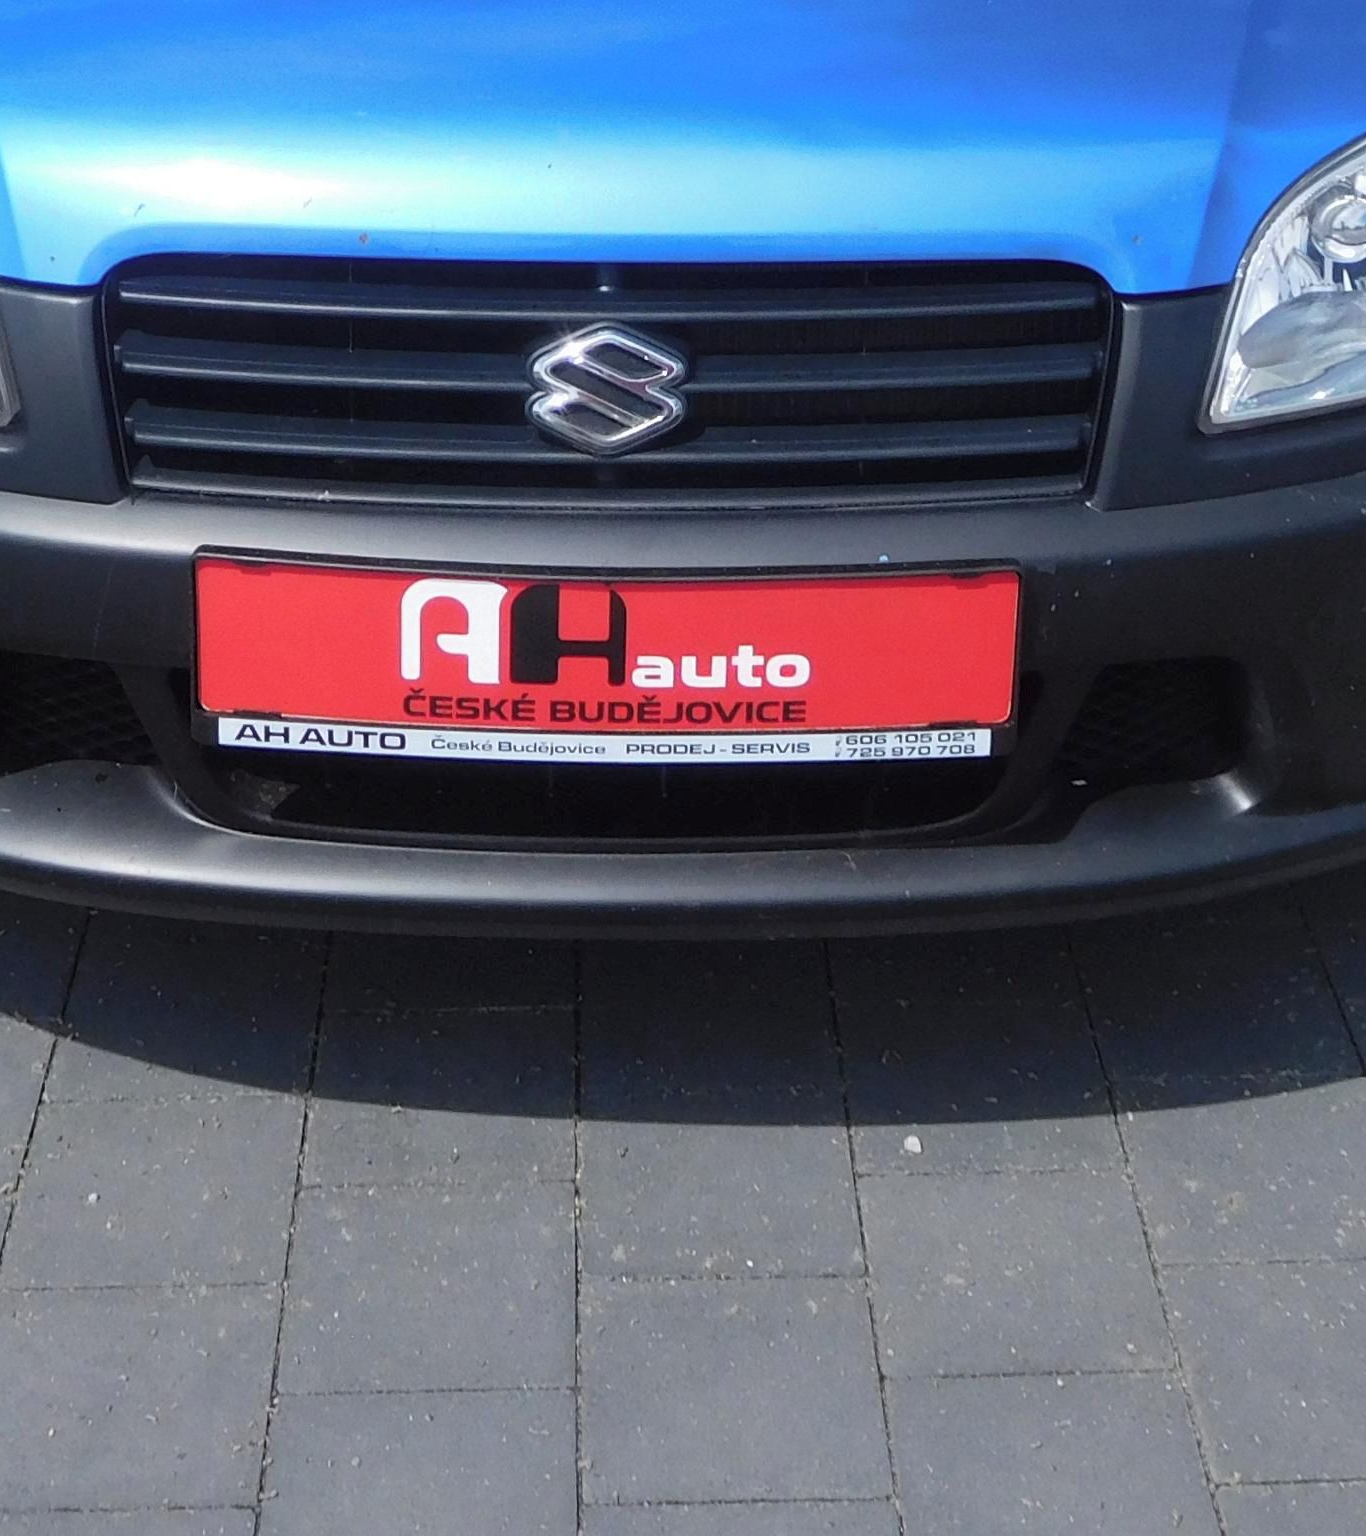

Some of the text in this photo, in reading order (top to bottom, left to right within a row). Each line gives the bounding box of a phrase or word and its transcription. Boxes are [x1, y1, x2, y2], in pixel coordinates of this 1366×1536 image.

[402, 688, 808, 724] ČESKÉ BUDĚJOVICE
[235, 724, 290, 744] AH
[299, 728, 406, 750] AUTO
[431, 735, 493, 751] České
[498, 740, 606, 756] Budějovice
[626, 744, 716, 755] PRODEJ
[731, 742, 810, 755] SERVIS
[846, 732, 976, 745] 606 105 021
[846, 744, 975, 758] 725 970 708
